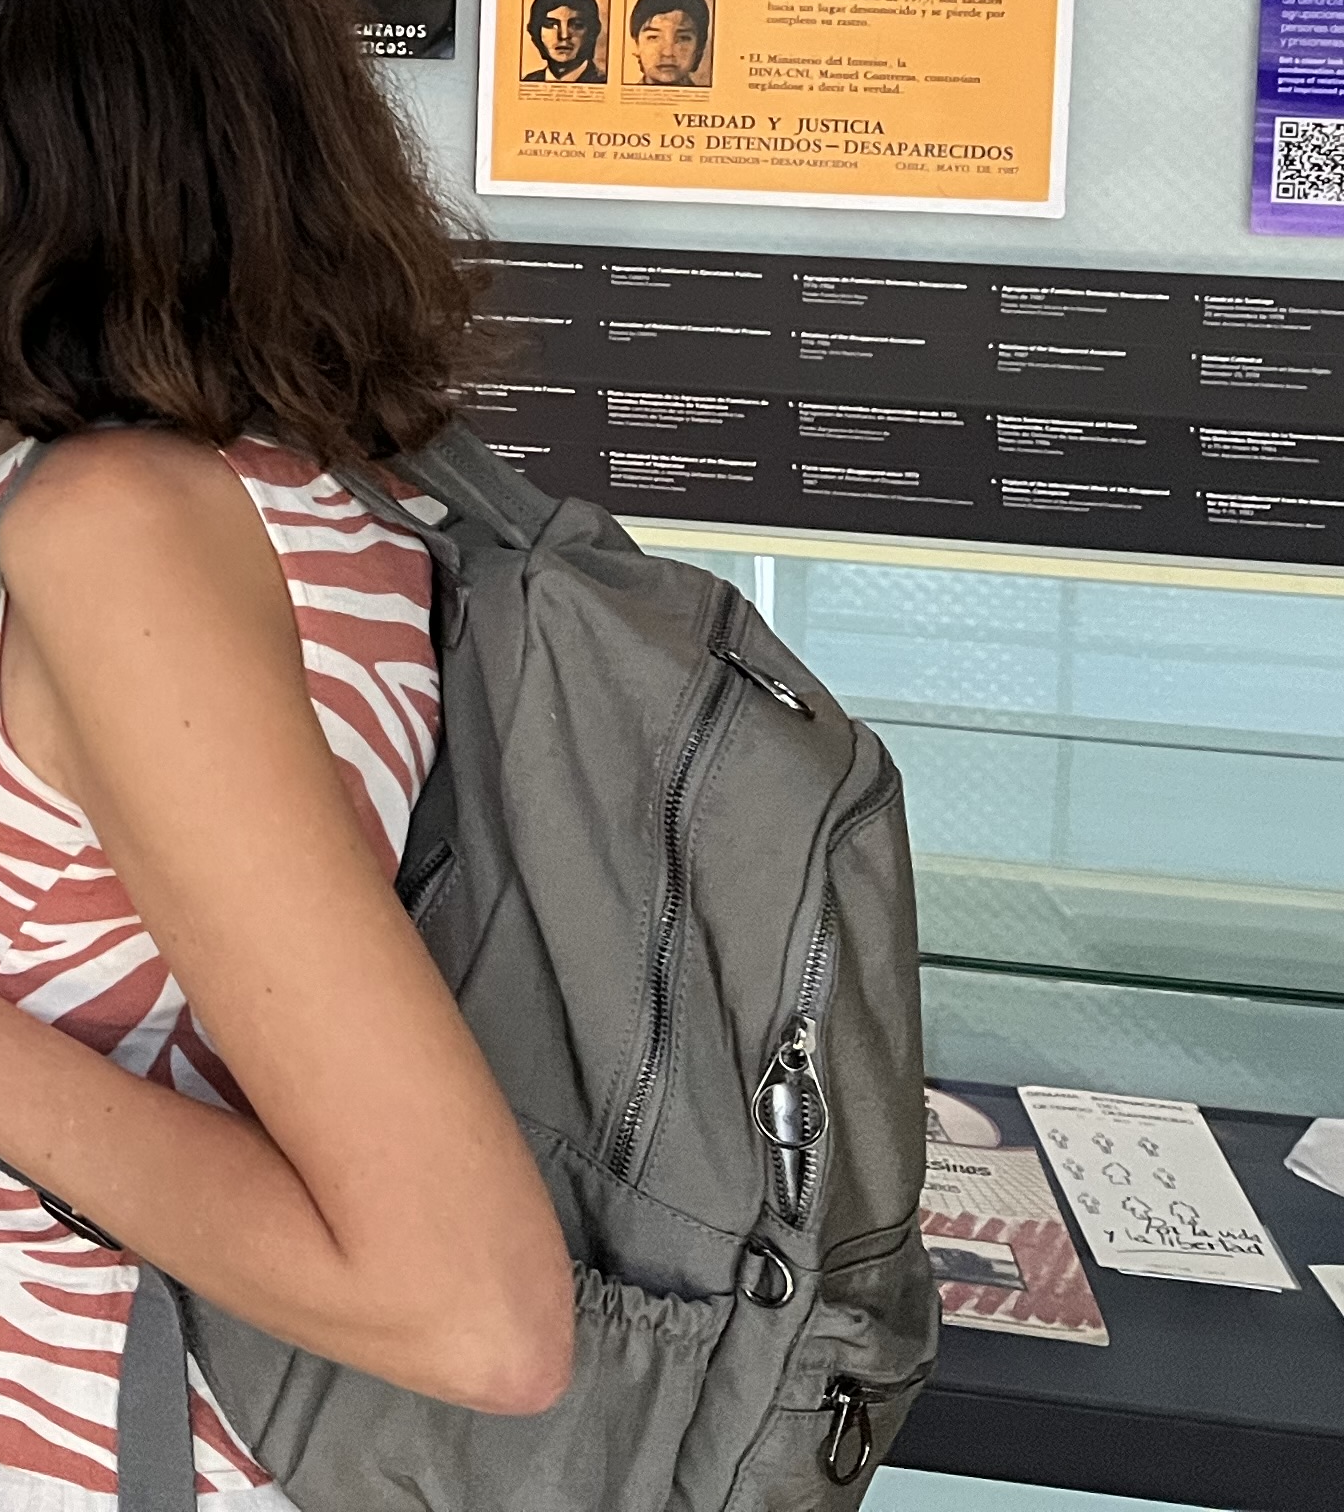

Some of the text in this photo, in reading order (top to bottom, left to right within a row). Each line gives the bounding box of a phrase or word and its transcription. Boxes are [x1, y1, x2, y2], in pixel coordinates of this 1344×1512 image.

[673, 113, 885, 135] VERDAD Y JUSTICIA
[524, 129, 575, 146] PARA
[585, 131, 651, 147] TODOS
[660, 134, 695, 149] LOS
